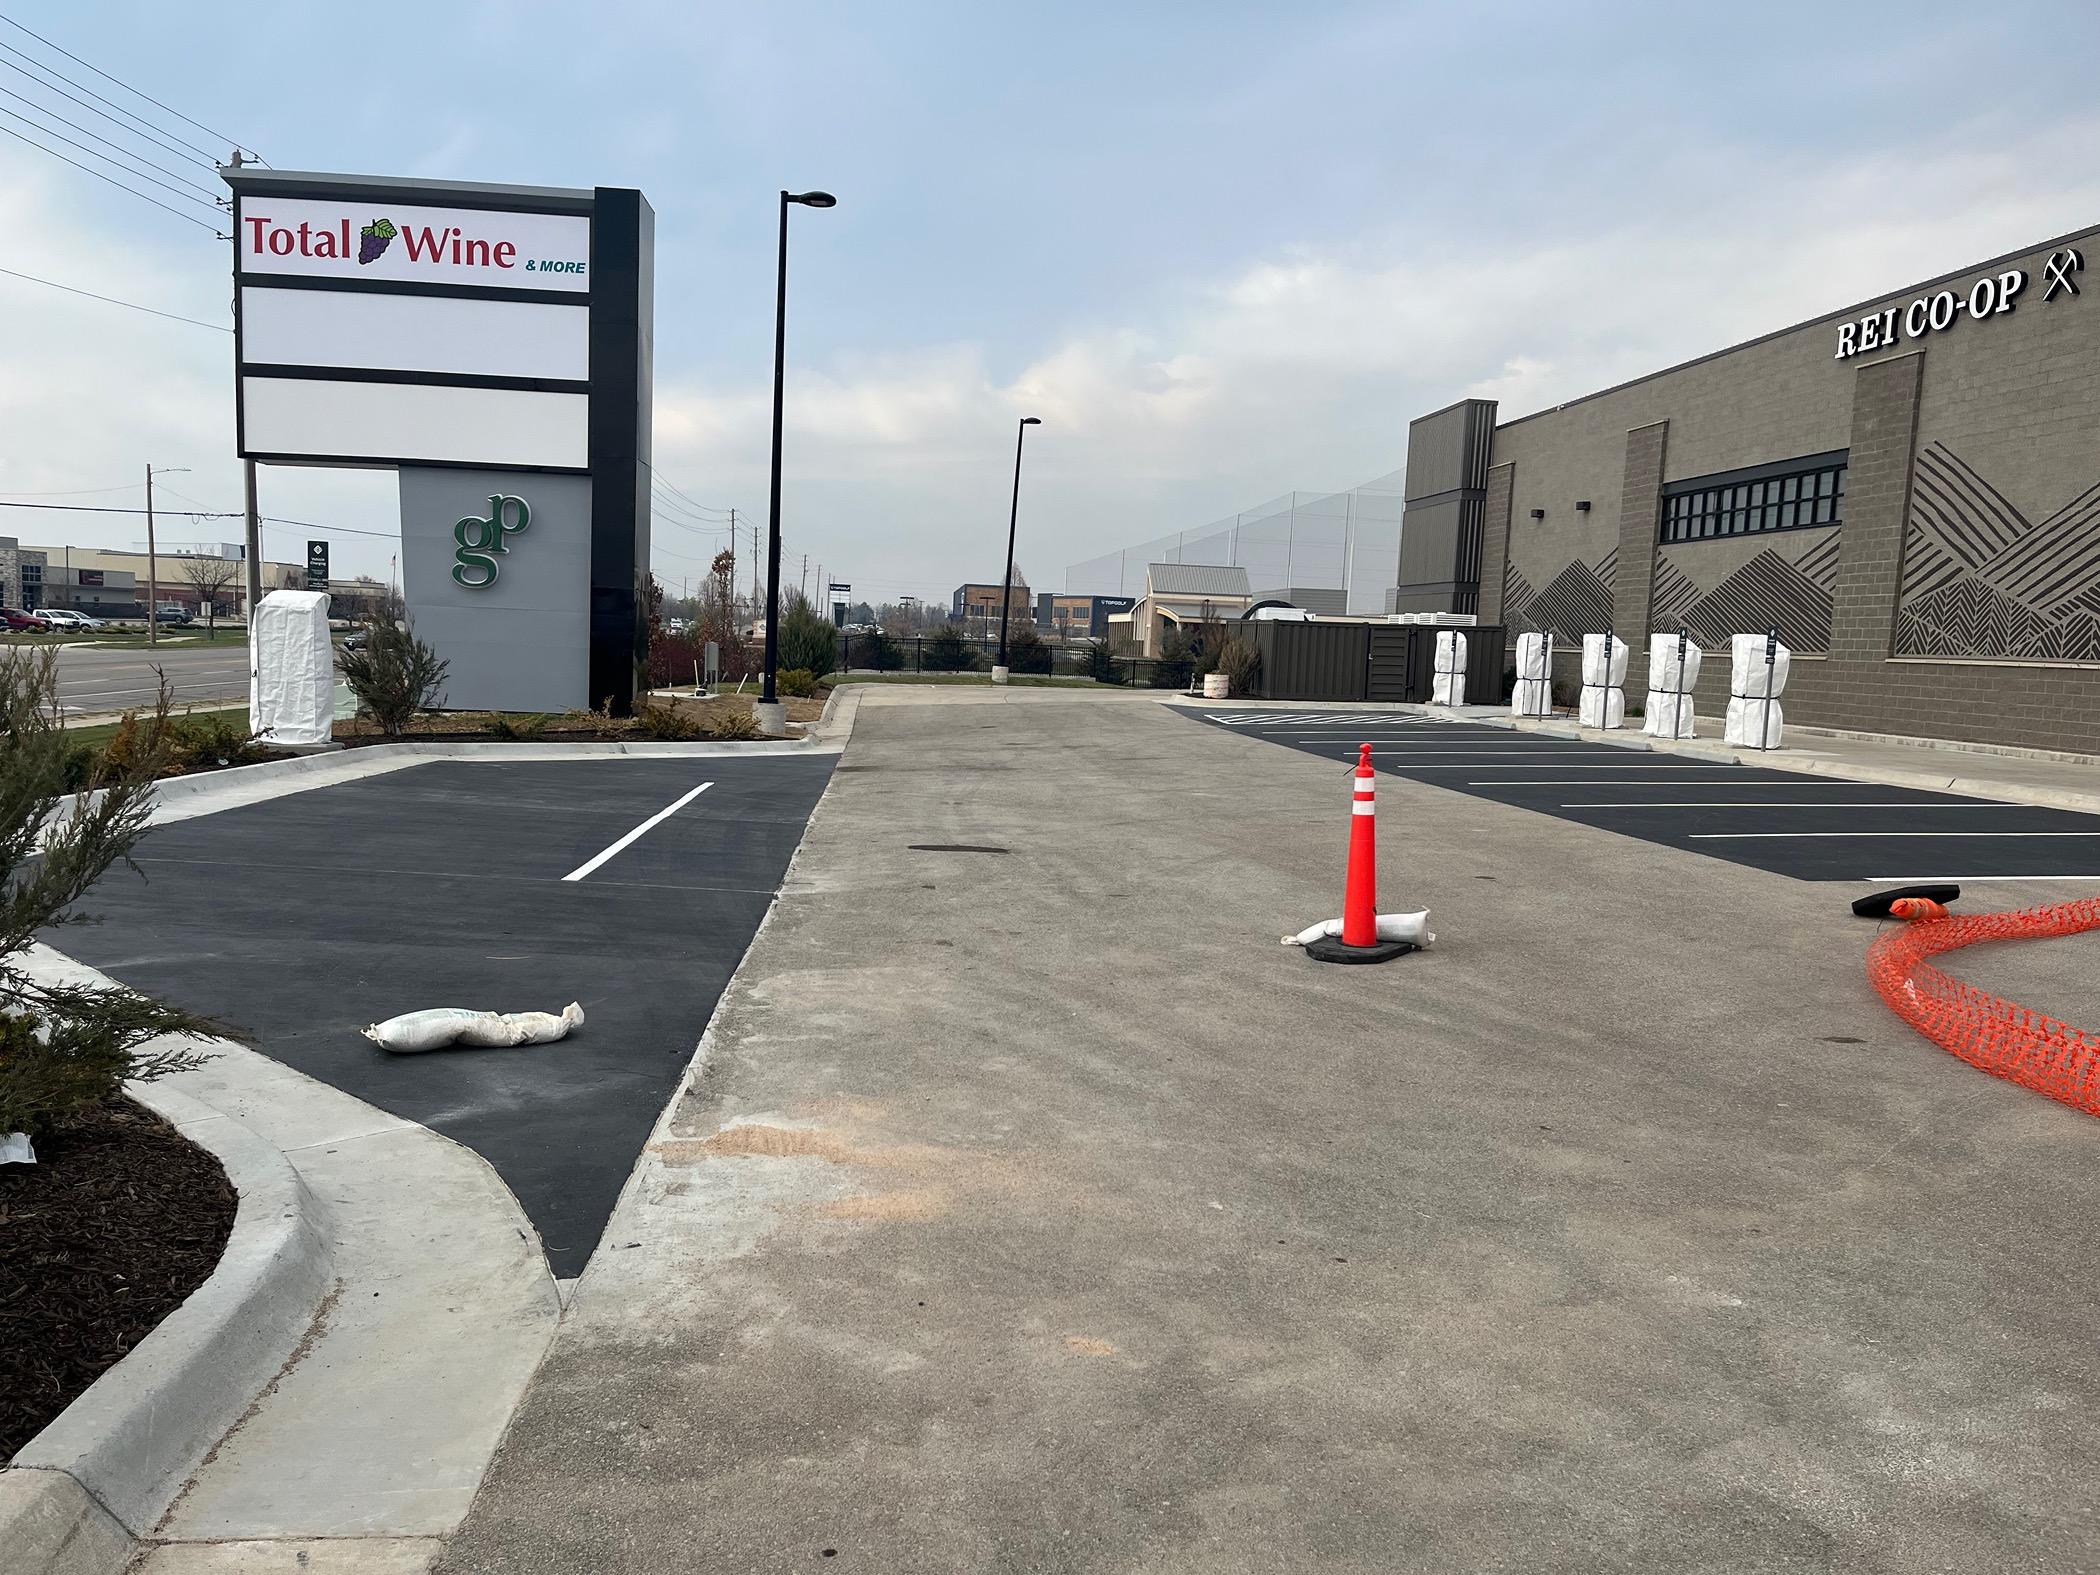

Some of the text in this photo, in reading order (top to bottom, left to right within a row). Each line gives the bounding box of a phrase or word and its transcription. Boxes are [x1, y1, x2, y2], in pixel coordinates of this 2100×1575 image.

[245, 217, 586, 273] Total Wine & MORE
[1834, 270, 2027, 360] REI CO-OP
[452, 494, 531, 588] gp
